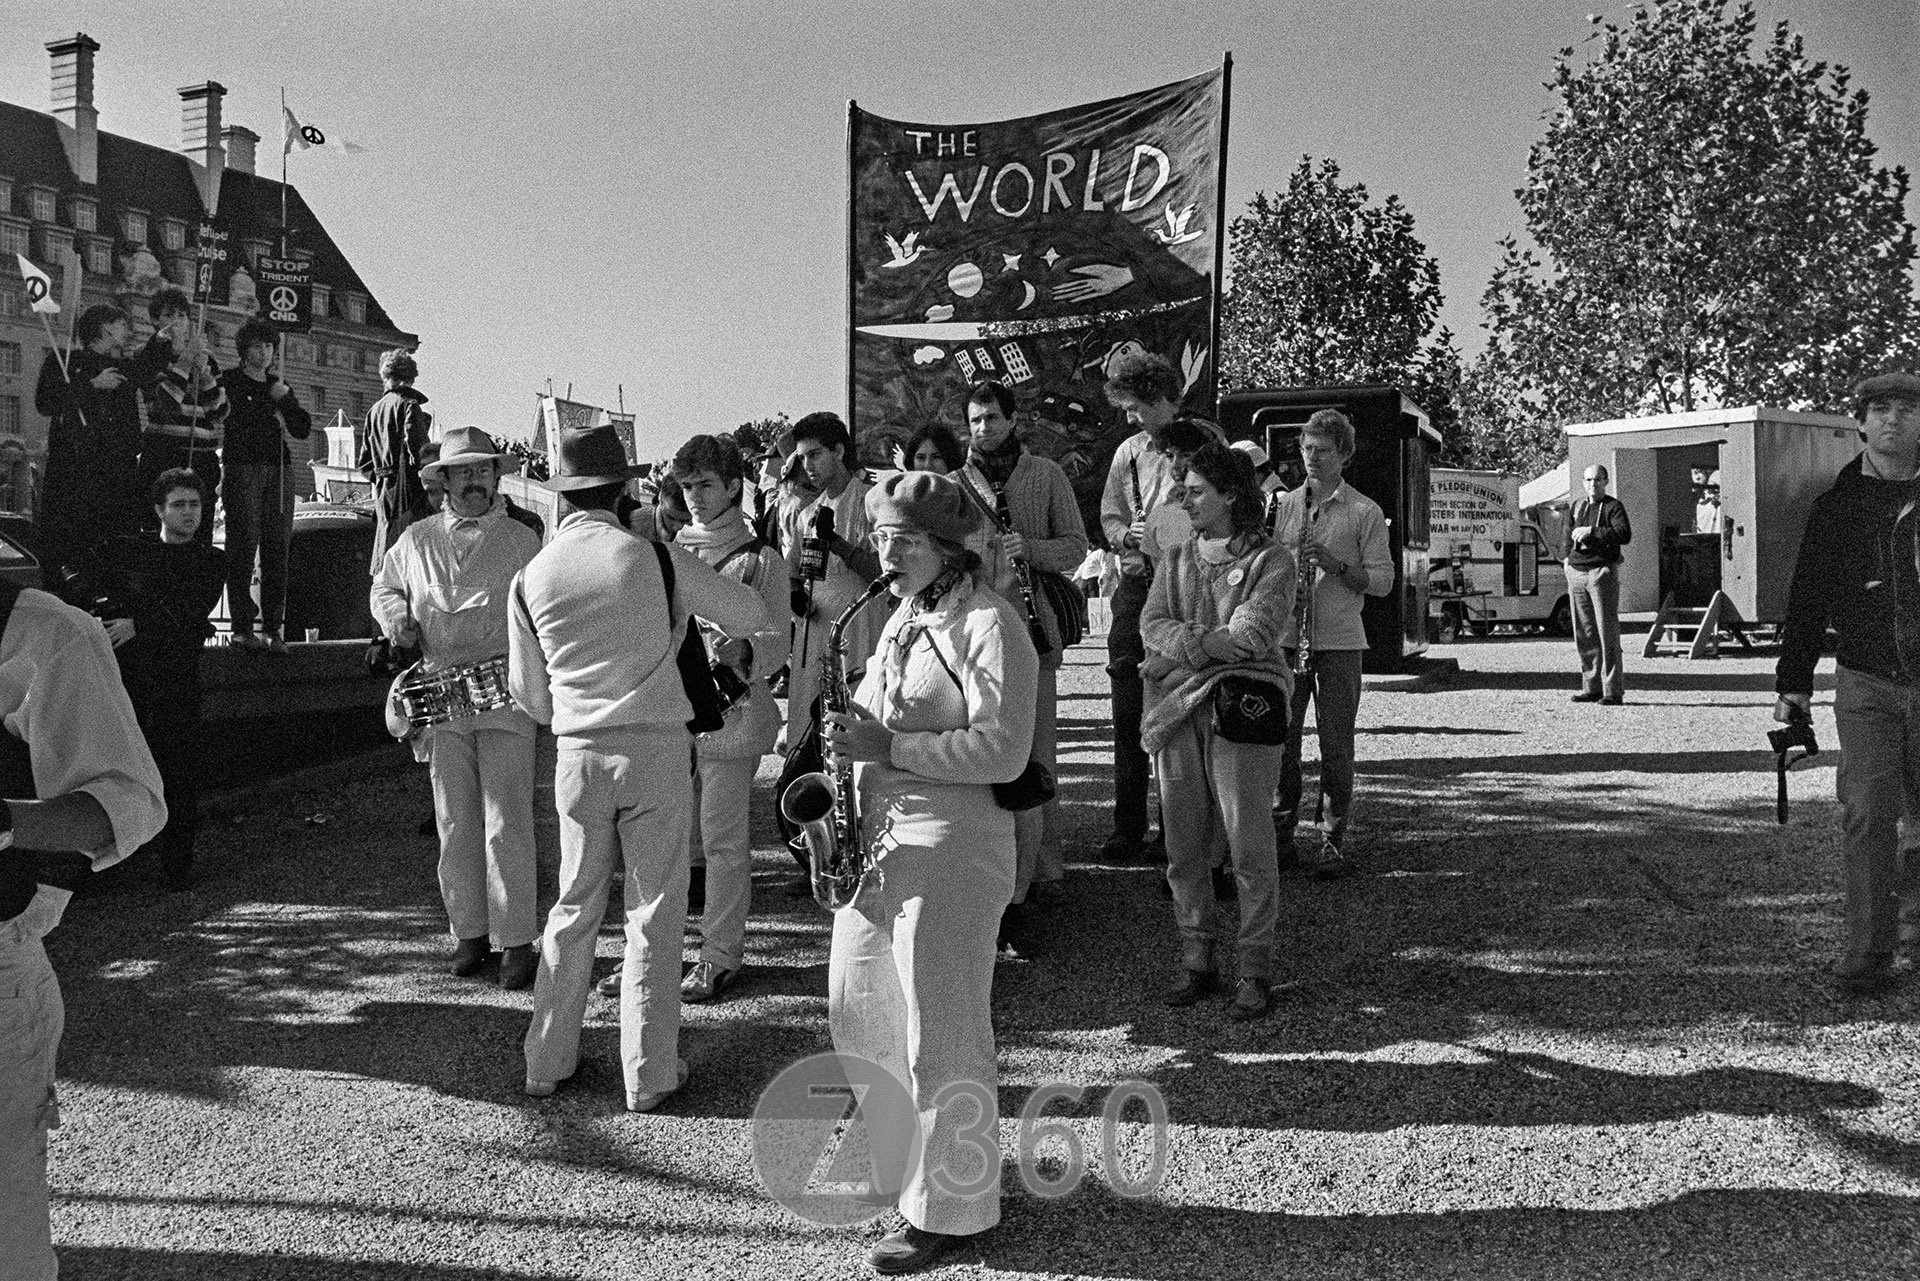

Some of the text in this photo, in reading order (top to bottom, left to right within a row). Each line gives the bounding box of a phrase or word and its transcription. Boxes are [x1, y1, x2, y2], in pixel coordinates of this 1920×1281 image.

[905, 130, 976, 157] THE
[904, 144, 1171, 222] WORLD
[261, 257, 310, 272] STOP
[261, 270, 309, 283] TRIDENT
[269, 310, 298, 322] CND
[1438, 482, 1470, 492] PLEDGE
[1473, 486, 1503, 505] UNION
[1449, 500, 1476, 509] SECTION
[1478, 501, 1487, 509] OF
[1459, 510, 1514, 520] INTERNATIONAL
[1429, 523, 1449, 534] WAR
